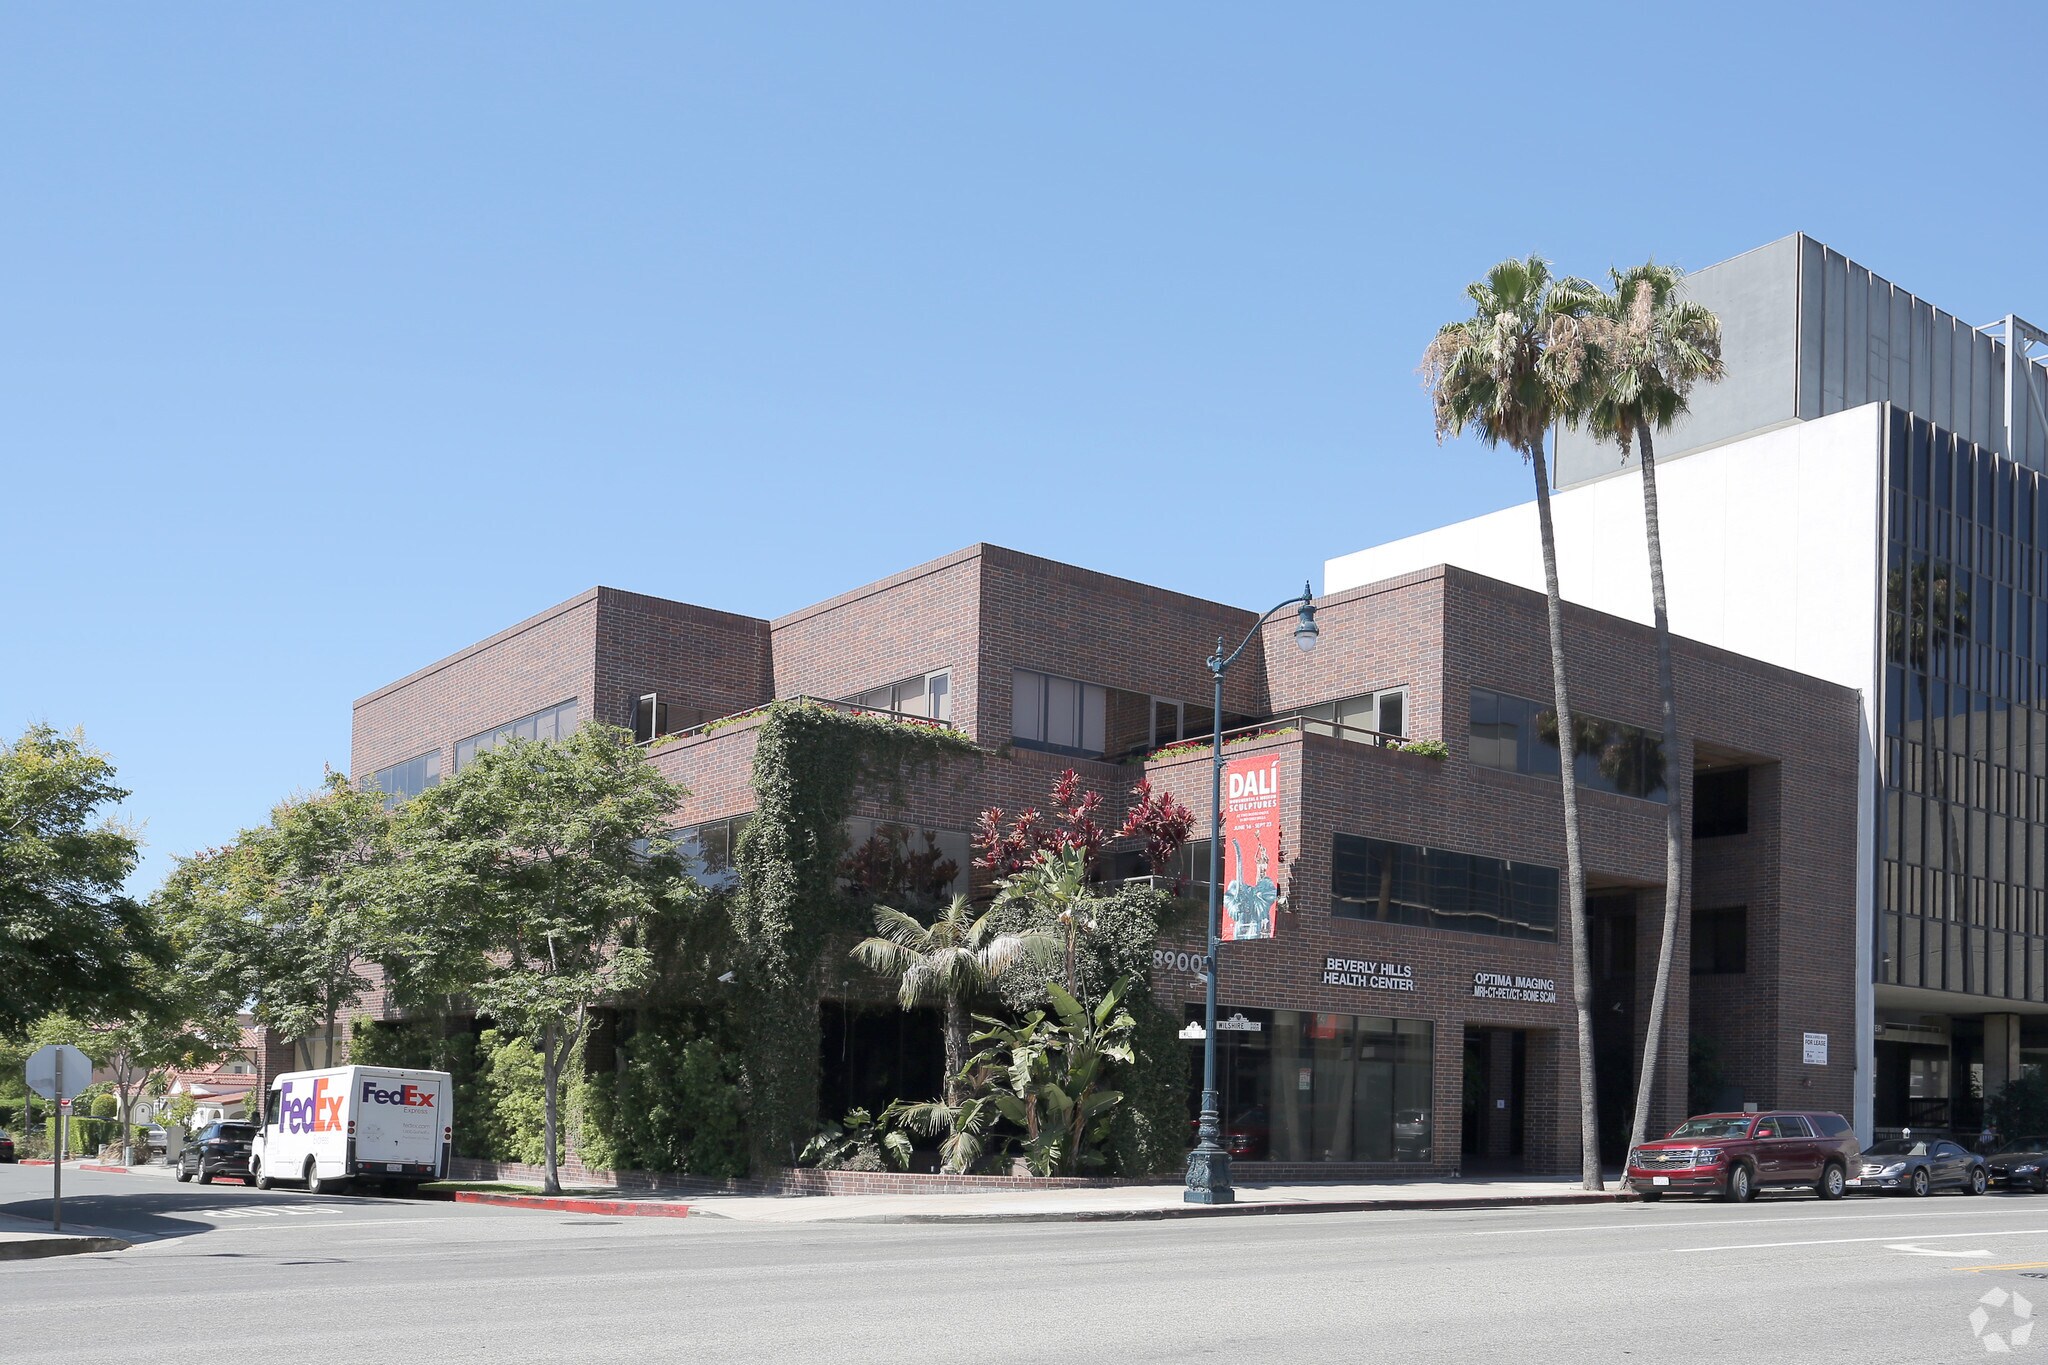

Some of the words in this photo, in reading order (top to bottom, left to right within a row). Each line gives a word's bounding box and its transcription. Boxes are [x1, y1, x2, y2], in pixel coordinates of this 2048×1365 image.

[1229, 760, 1279, 799] DALÍ
[1229, 800, 1277, 813] SCULPTURES
[1152, 949, 1202, 973] 8900
[1326, 957, 1377, 974] BEVERLY
[1380, 963, 1411, 977] HILLS
[1323, 971, 1366, 987] HEALTH
[1370, 976, 1414, 991] CENTER
[1475, 972, 1512, 987] OPTIMA
[1515, 976, 1554, 991] IMAGING
[1218, 1022, 1244, 1030] WILSHIRE
[362, 1081, 435, 1108] FedEx
[279, 1078, 344, 1135] FedEx
[403, 1106, 428, 1115] Express
